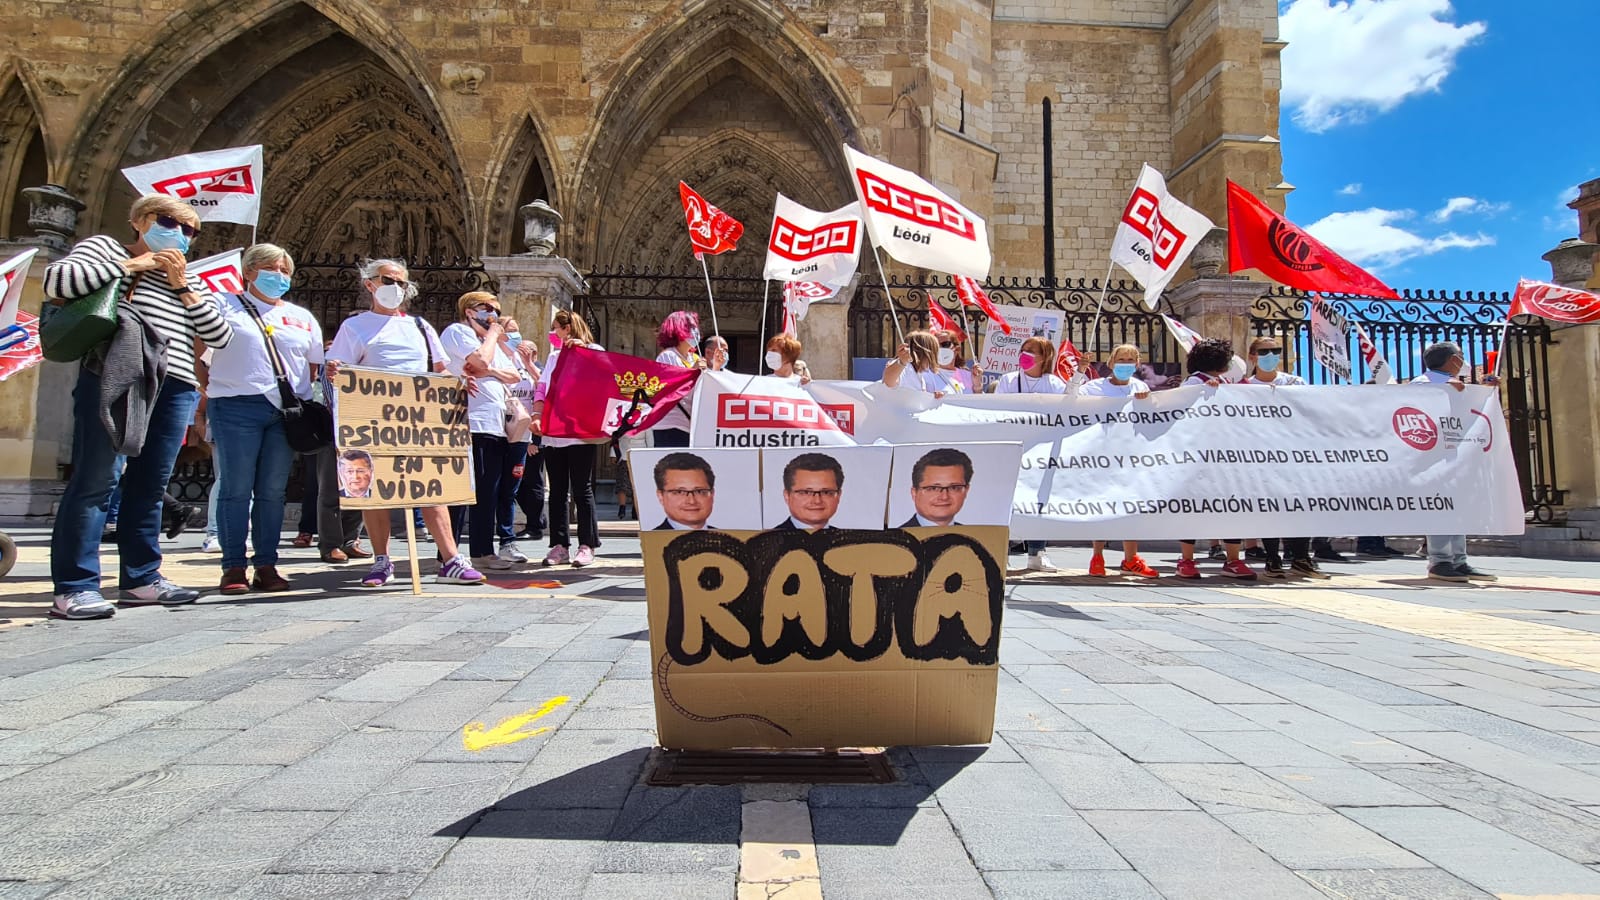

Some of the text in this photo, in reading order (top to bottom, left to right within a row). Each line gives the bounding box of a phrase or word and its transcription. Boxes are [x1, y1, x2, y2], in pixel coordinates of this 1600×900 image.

[190, 197, 219, 207] eón
[865, 177, 967, 233] CCOO
[774, 224, 850, 256] CCOO
[892, 225, 932, 245] León
[1130, 241, 1152, 264] Leó
[791, 262, 818, 276] León
[989, 346, 1020, 358] AHOR
[985, 356, 999, 370] YA
[338, 370, 403, 398] JUAN
[382, 403, 426, 424] PON
[725, 399, 819, 423] CCOO
[1069, 413, 1092, 427] DE
[1224, 404, 1293, 419] OVEJERO
[1396, 413, 1432, 432] UGT
[1439, 416, 1463, 431] FICA
[715, 429, 820, 448] industria
[392, 455, 465, 475] EN TU
[1038, 455, 1110, 470] SALARIO
[1114, 455, 1125, 469] Y
[1129, 453, 1169, 468] POR
[1172, 449, 1196, 465] LA
[1197, 449, 1289, 464] VIABILIDAD
[1291, 449, 1323, 464] DEL
[1324, 449, 1389, 463] EMPLEO
[376, 474, 443, 501] VIDA
[1012, 492, 1455, 516] ALIZACIÓN Y DESPOBLACIÓN EN LA PROVINCIA DE LEÓN
[667, 536, 998, 661] RATA
